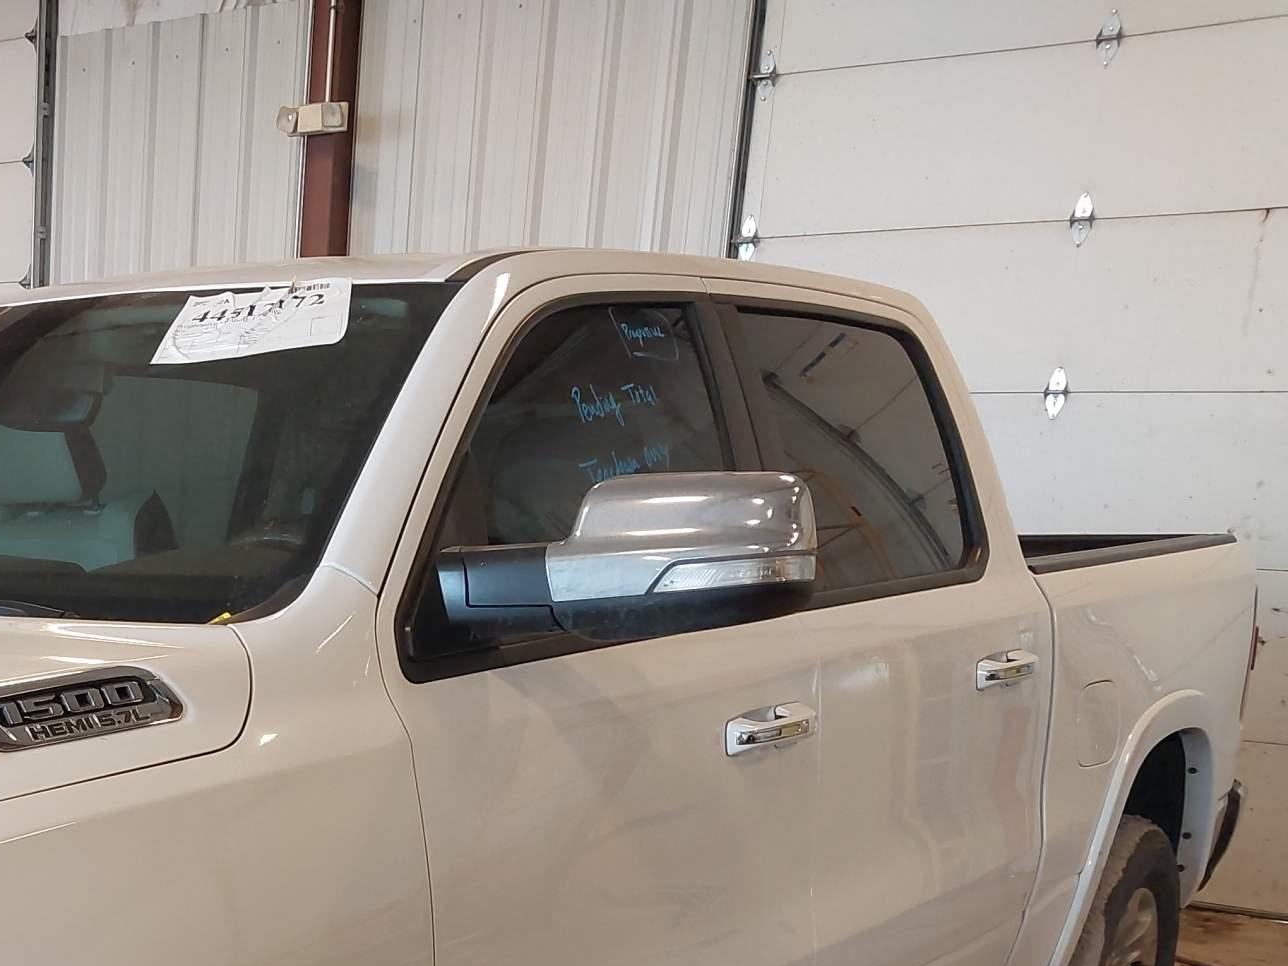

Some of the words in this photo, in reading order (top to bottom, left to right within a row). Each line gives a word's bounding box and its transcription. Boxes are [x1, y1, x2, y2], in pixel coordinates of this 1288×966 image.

[571, 384, 625, 427] Pending
[620, 383, 659, 407] Total
[25, 715, 94, 742] HEMI
[94, 706, 151, 728] 5.7L
